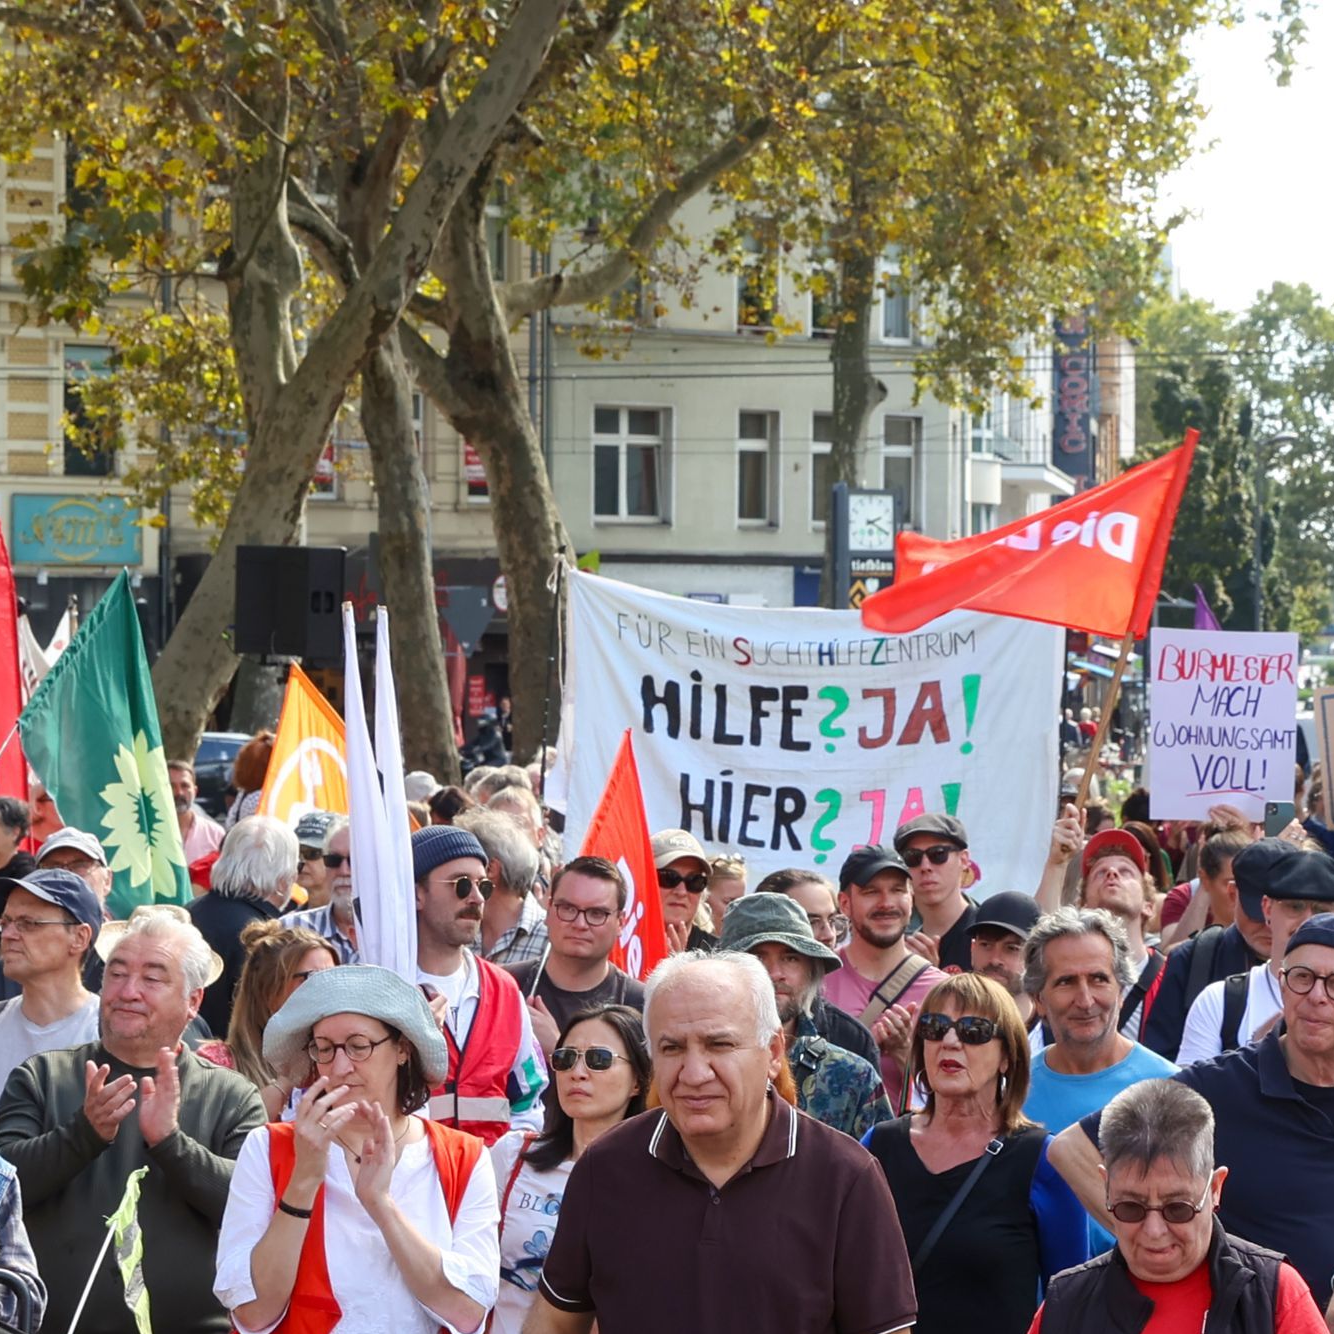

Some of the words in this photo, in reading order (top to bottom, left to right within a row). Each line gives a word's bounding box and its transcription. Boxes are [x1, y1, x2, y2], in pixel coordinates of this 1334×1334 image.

[617, 612, 676, 656] FÜR
[1190, 683, 1262, 718] MACH
[1153, 721, 1296, 751] WOHNUNGSAMT
[1191, 753, 1267, 791] VOLL!
